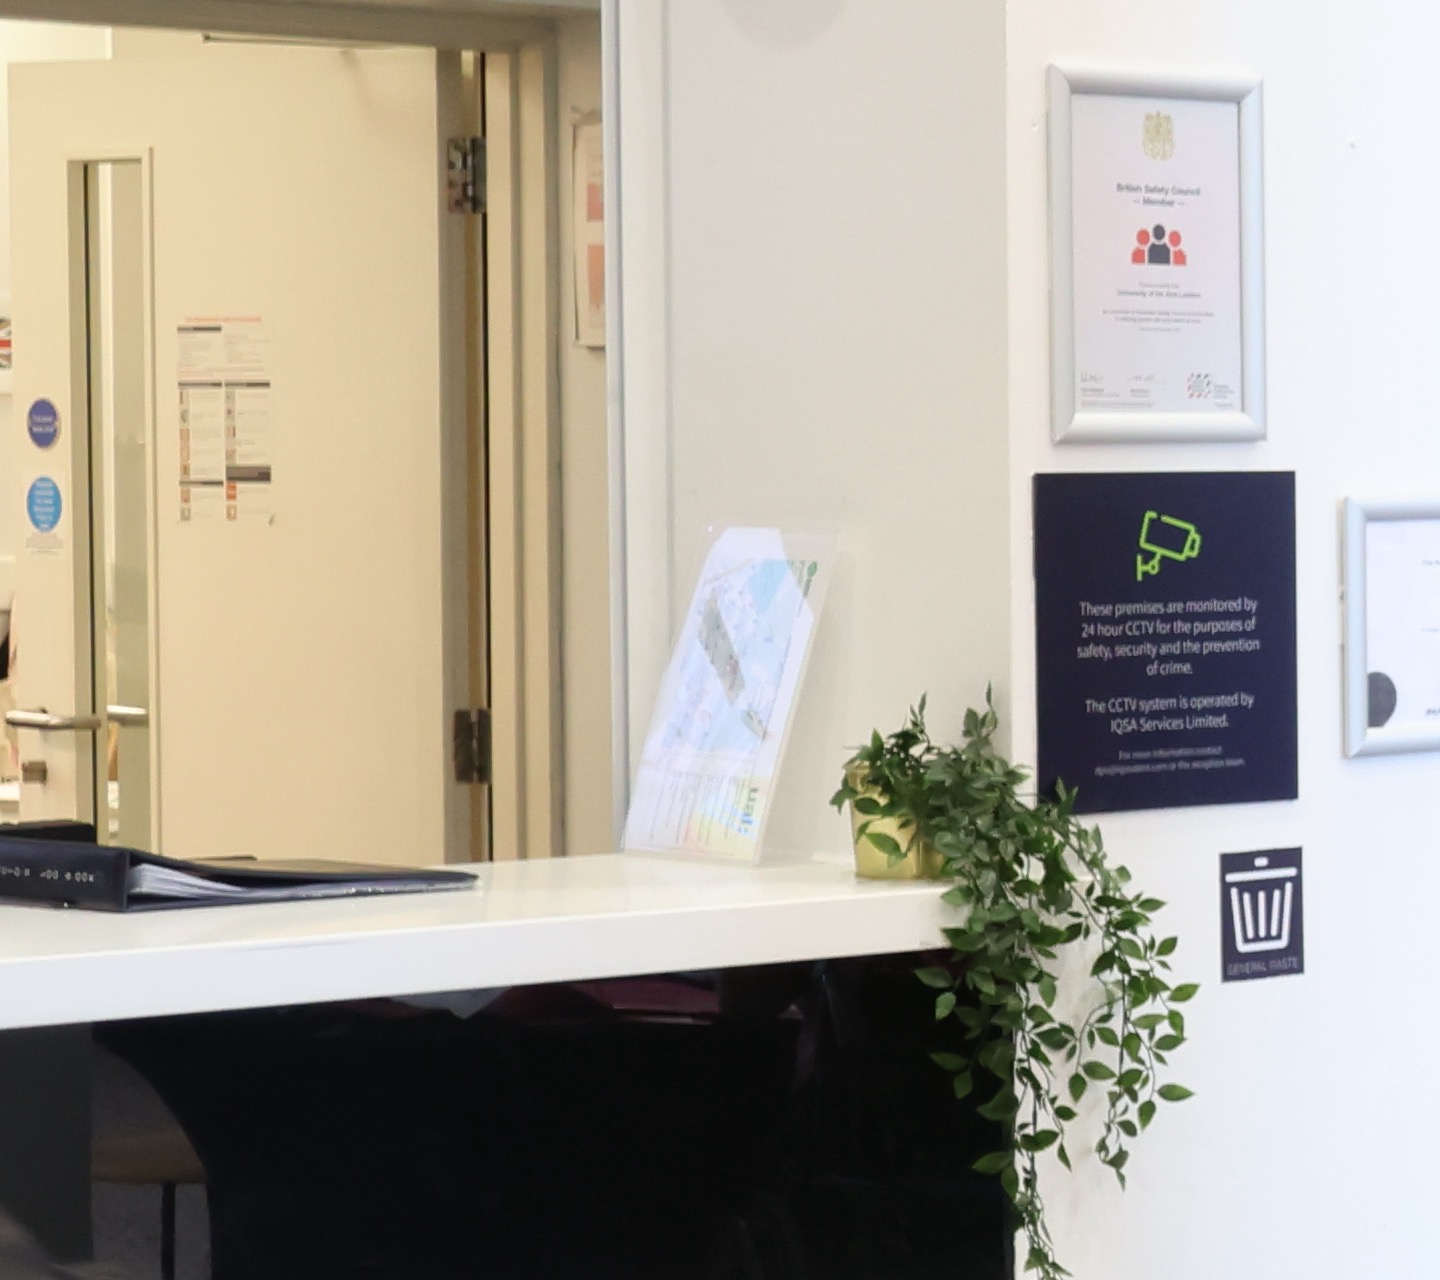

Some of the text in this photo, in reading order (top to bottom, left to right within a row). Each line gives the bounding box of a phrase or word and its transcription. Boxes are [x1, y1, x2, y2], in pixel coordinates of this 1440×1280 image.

[1079, 597, 1258, 618] These premises are monitored by
[1082, 616, 1256, 638] 24 hour CCTV for the purposes of
[1077, 638, 1260, 661] safety, security and the prevention
[1146, 661, 1193, 675] of crime.
[1086, 692, 1254, 714] The CCTV system is operated by
[1111, 714, 1229, 735] IQSA Services Limited.
